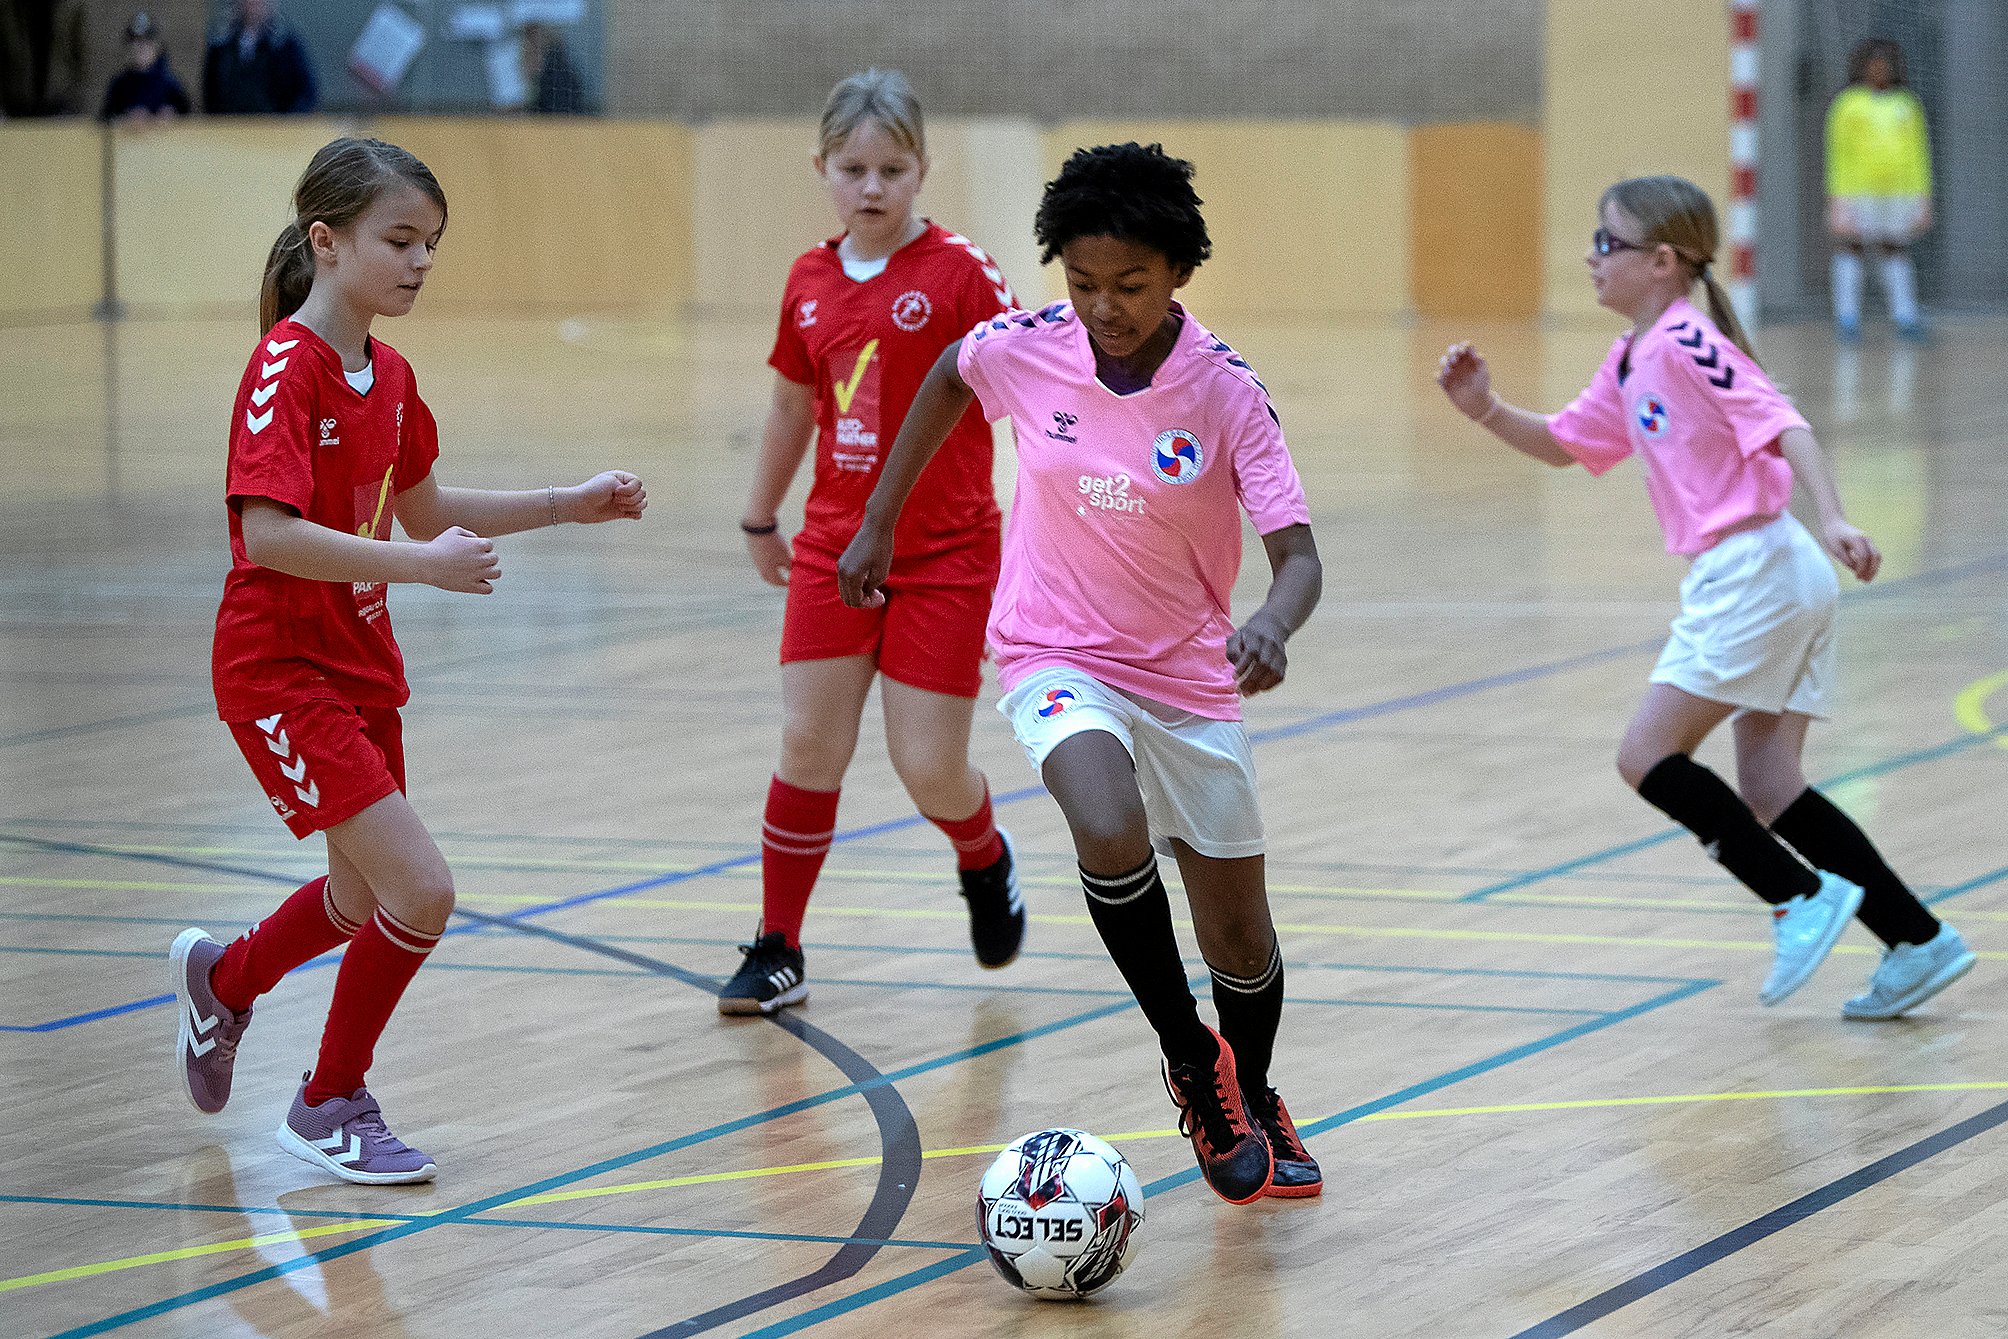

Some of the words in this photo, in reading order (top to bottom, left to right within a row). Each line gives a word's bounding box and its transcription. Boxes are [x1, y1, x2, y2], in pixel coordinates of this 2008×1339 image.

[1078, 473, 1131, 497] get2
[1088, 492, 1147, 514] sport
[995, 1214, 1083, 1241] SELECT
